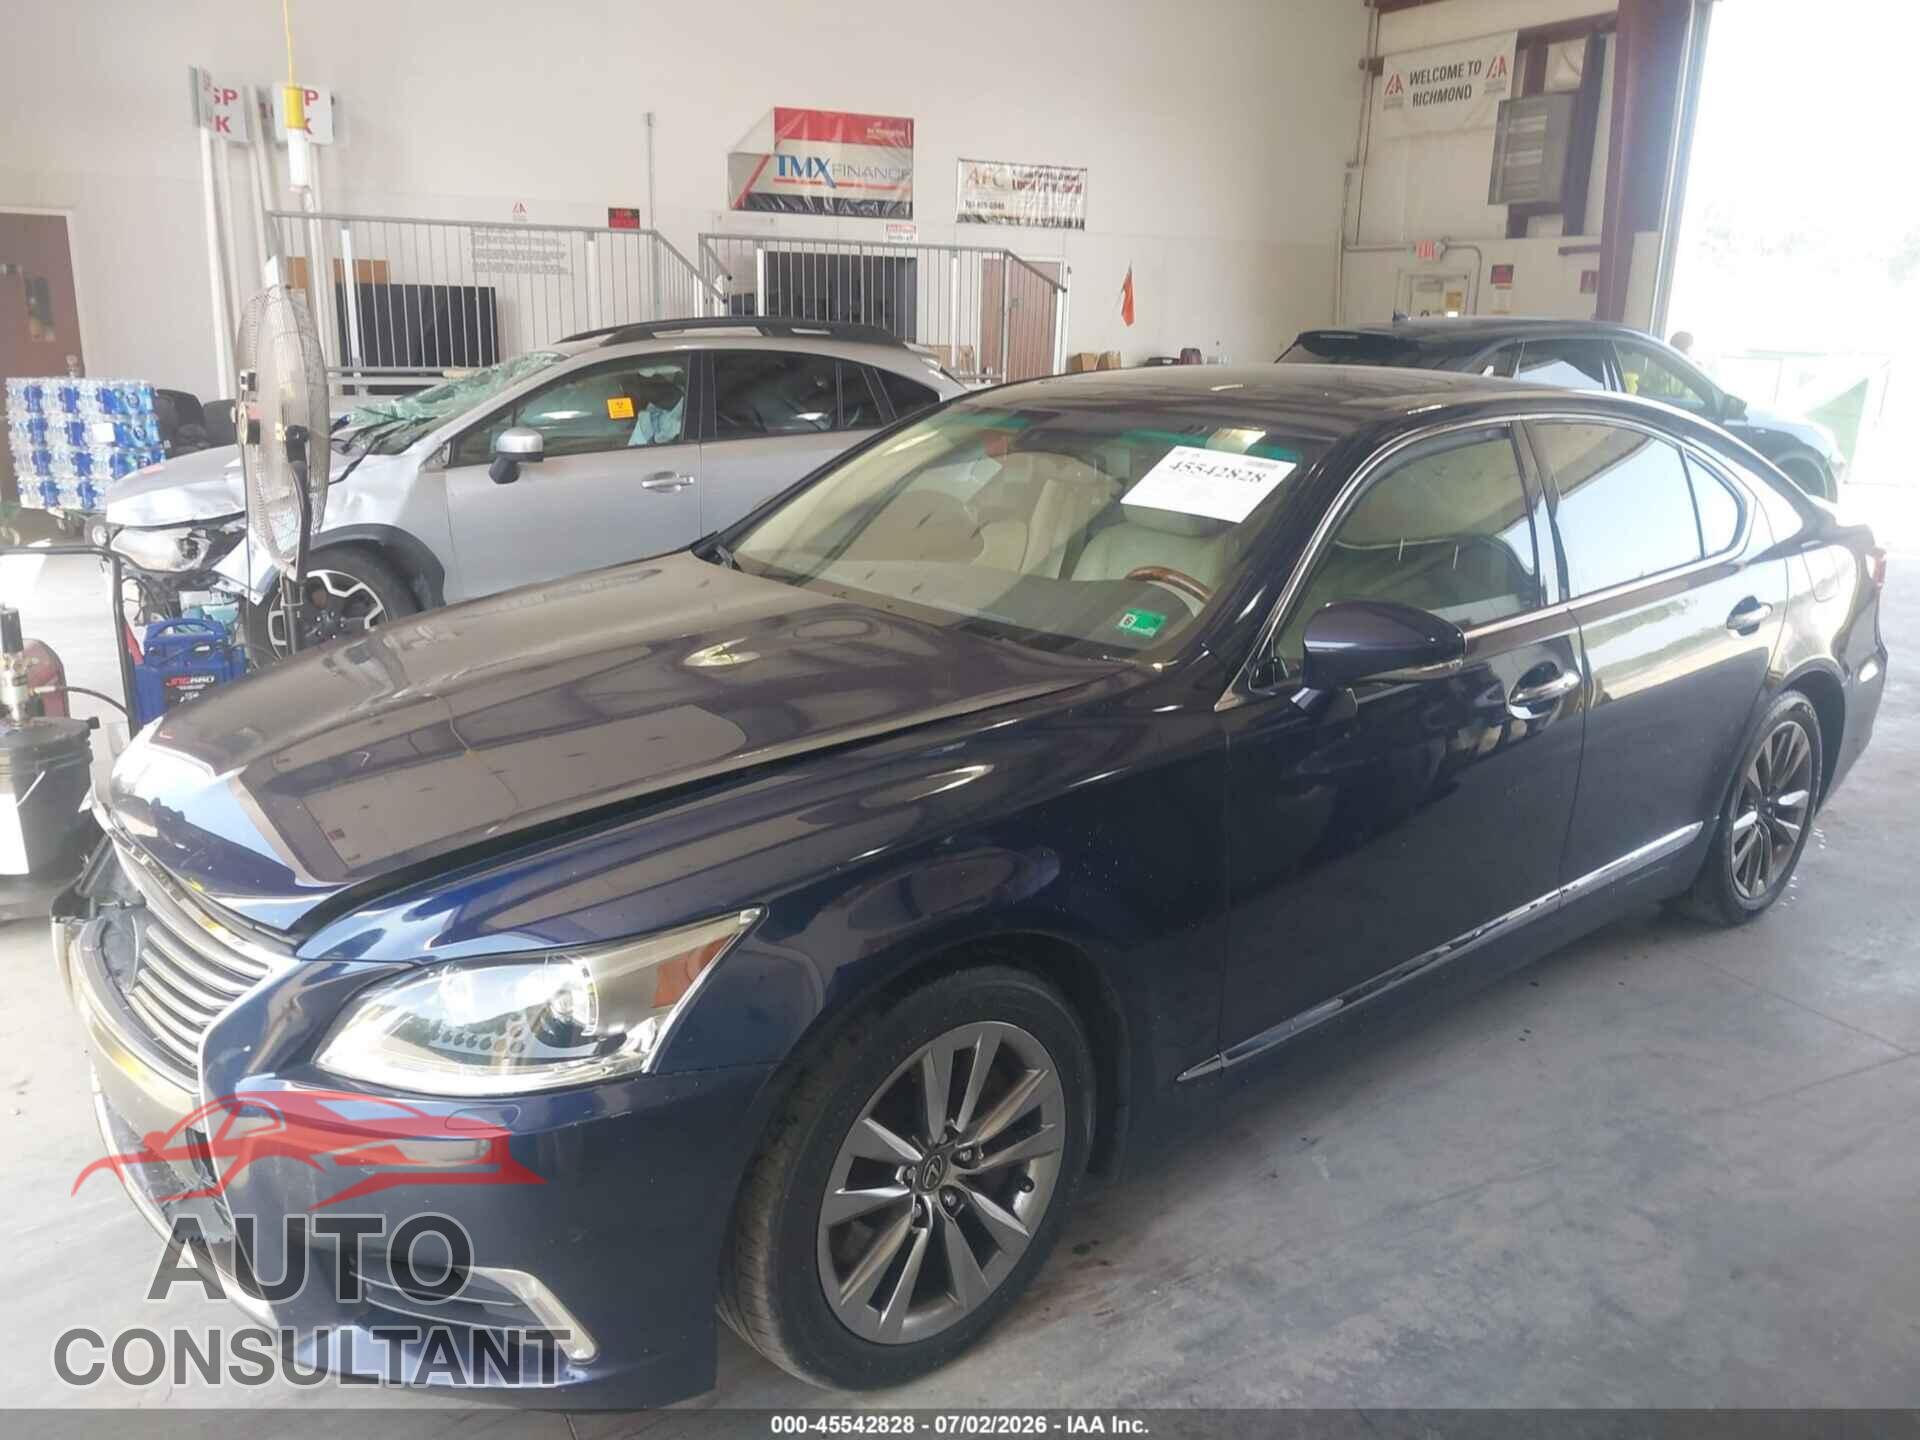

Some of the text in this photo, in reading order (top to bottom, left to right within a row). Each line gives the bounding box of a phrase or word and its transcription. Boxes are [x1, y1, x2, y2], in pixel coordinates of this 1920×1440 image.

[1409, 60, 1482, 86] WELCOME TO
[1412, 83, 1473, 108] RICHMOND
[774, 153, 837, 189] TMX
[1170, 460, 1267, 484] 45542828
